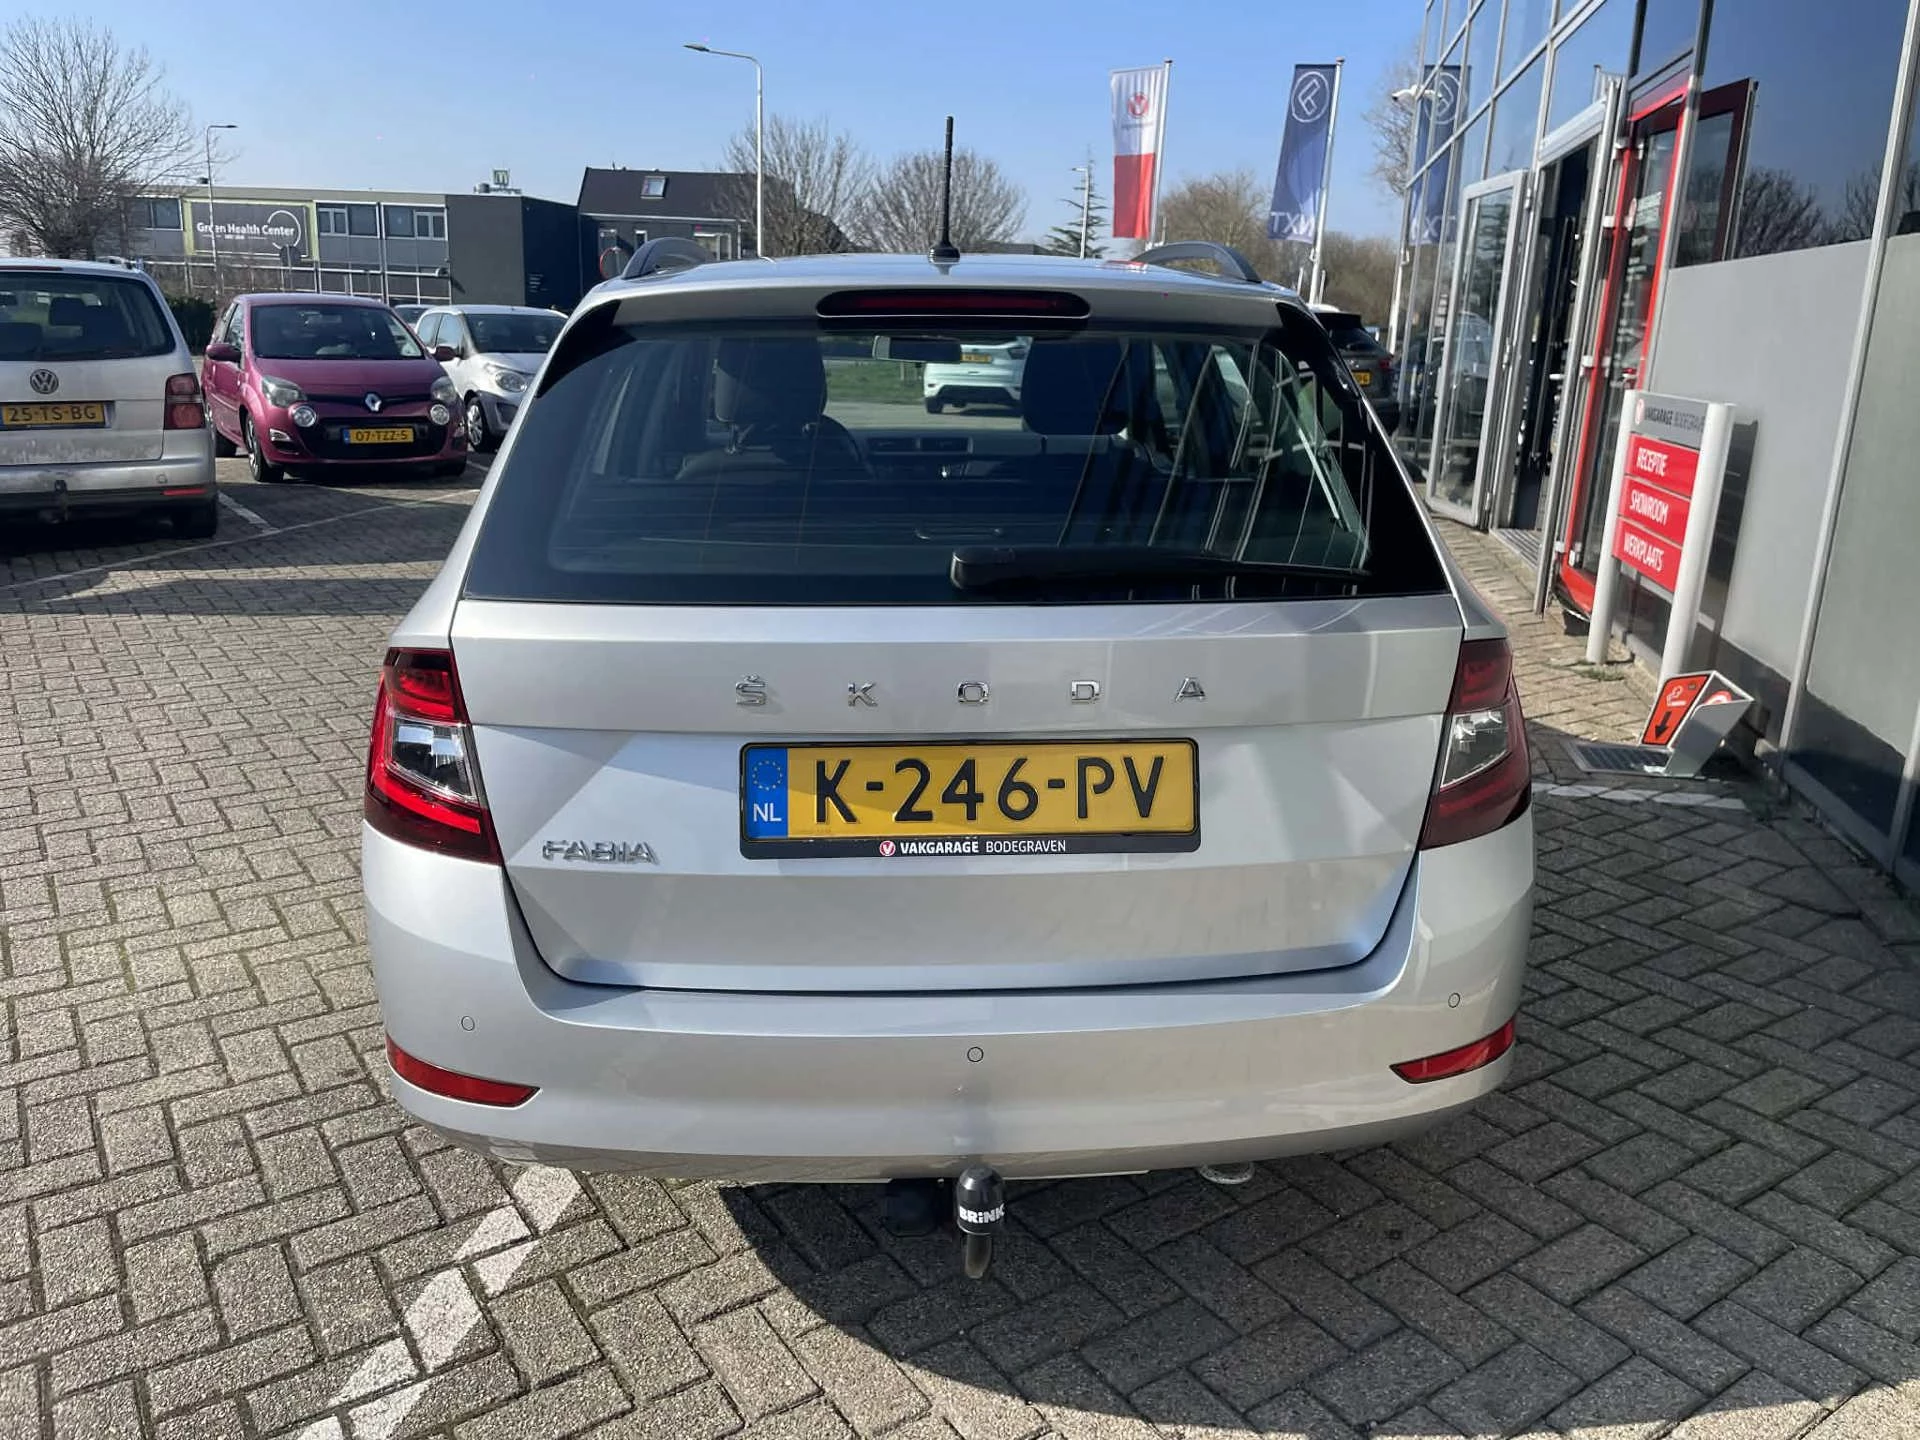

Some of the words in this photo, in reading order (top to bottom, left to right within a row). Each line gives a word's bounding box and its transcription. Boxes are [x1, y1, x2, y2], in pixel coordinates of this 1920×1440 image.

[228, 223, 260, 235] Health
[262, 224, 295, 236] Center
[9, 405, 97, 422] 25-TS-BG
[1636, 447, 1668, 477] RECEPTIE
[1630, 489, 1669, 526] SHOWROOM
[1624, 531, 1664, 572] WERKPLAATS
[816, 756, 1164, 823] K-246-PV
[753, 803, 781, 822] NL
[542, 840, 659, 865] FABIA
[900, 841, 979, 854] VAKGARAGE
[986, 839, 1066, 853] BODEGRAVEN
